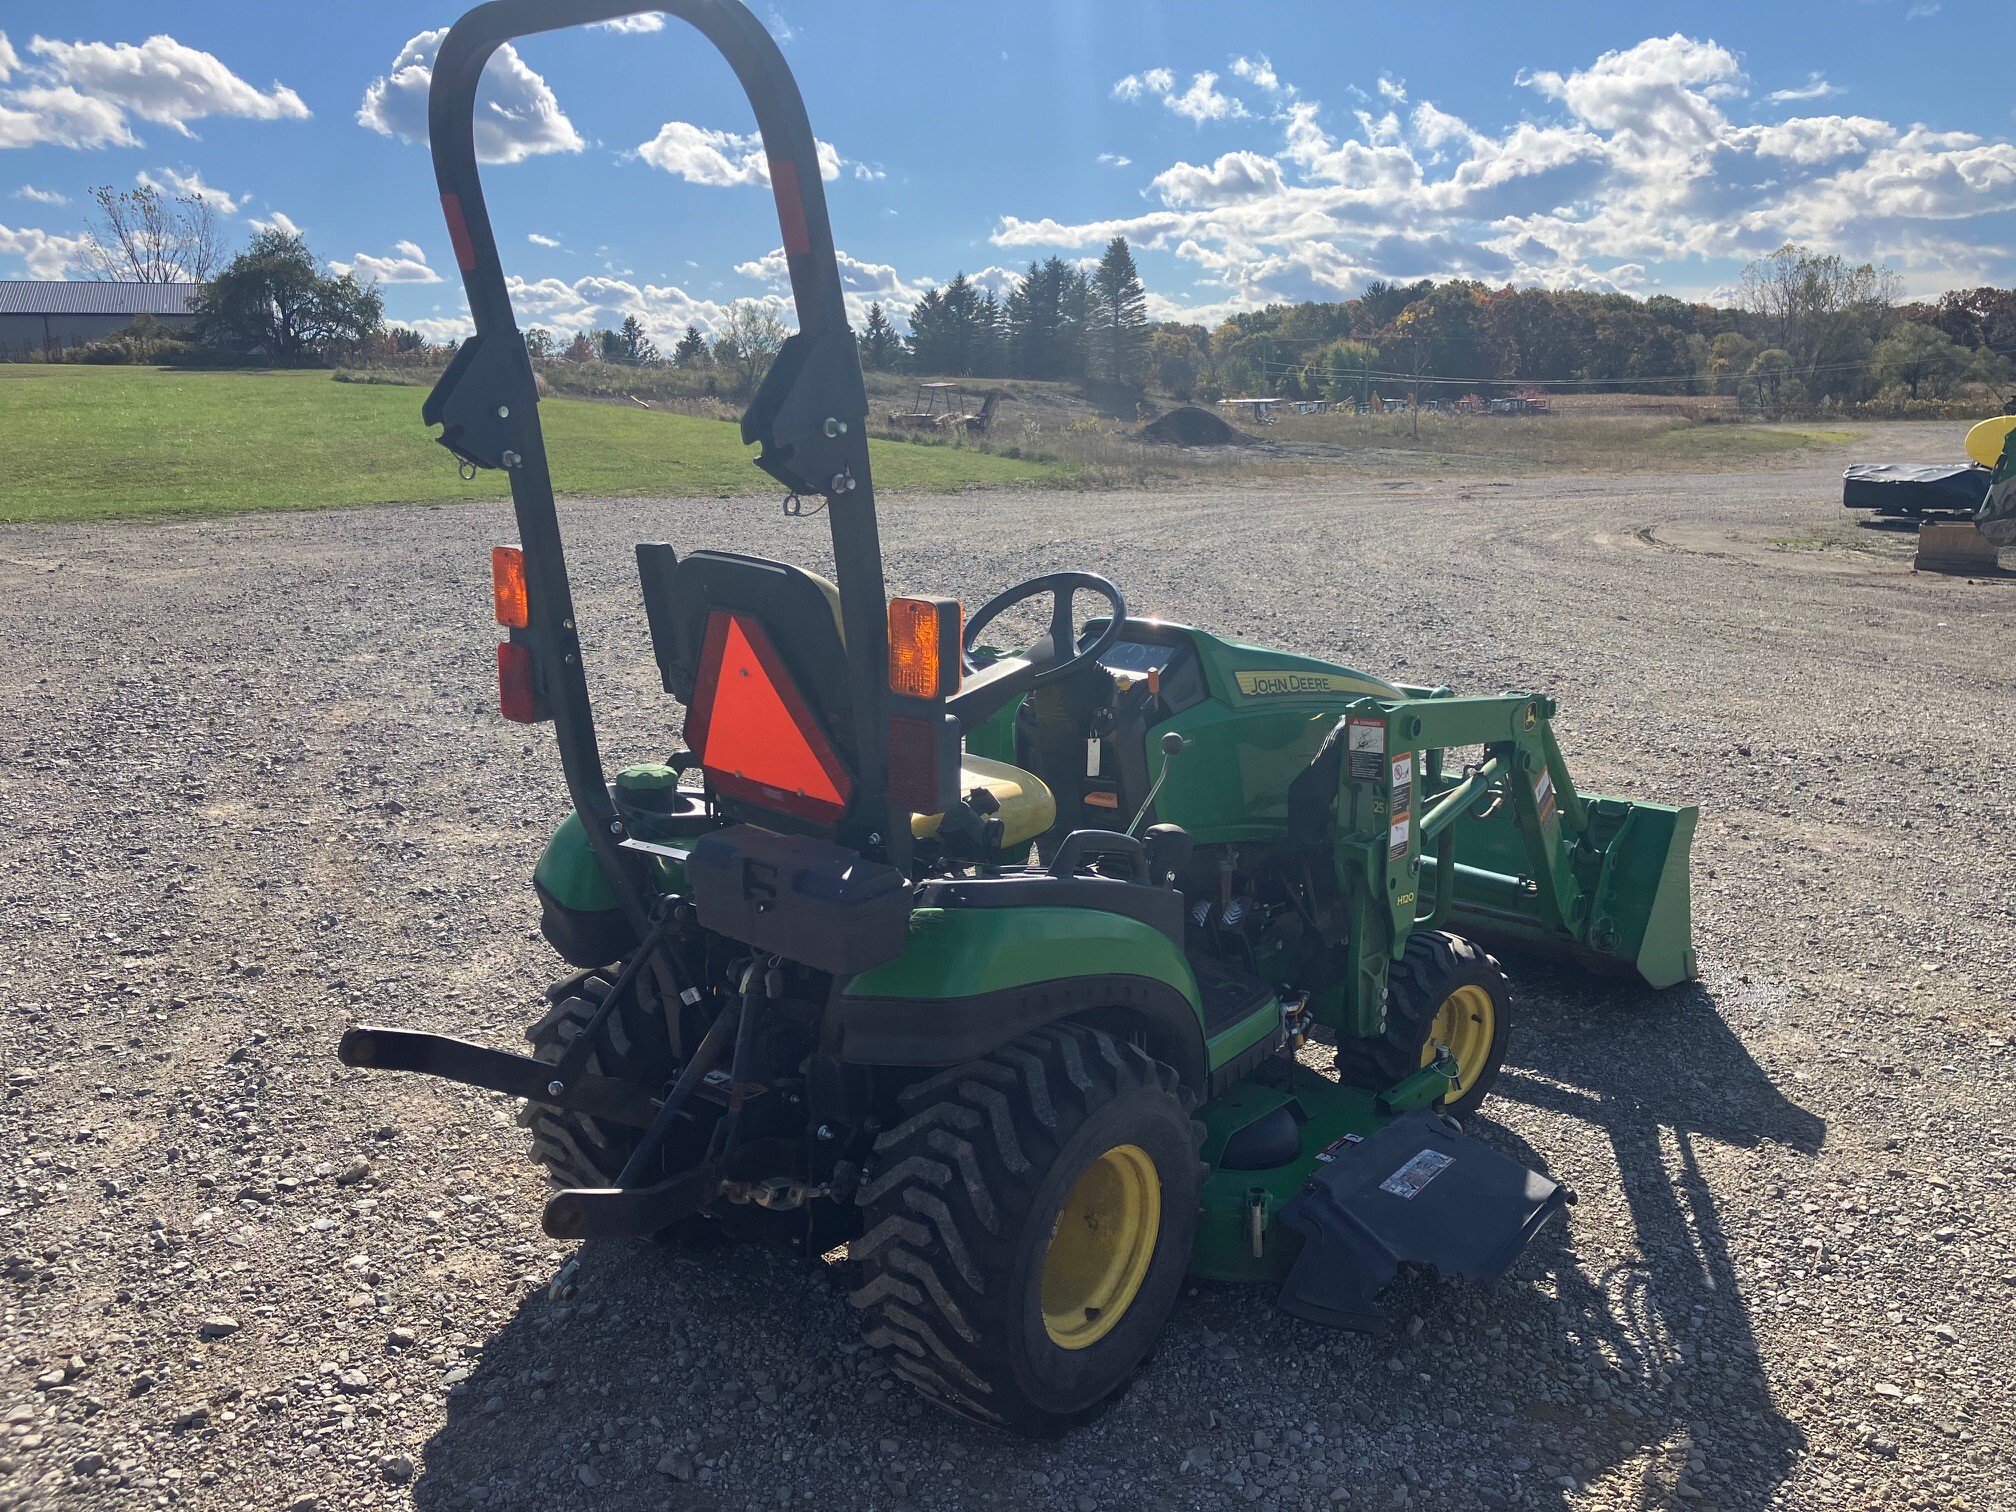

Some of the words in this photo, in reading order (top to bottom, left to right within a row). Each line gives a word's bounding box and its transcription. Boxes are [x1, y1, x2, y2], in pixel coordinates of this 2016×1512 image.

[1251, 677, 1288, 694] JOHN
[1289, 675, 1331, 691] DEERE
[1373, 800, 1388, 815] 25
[1397, 892, 1414, 906] H120
